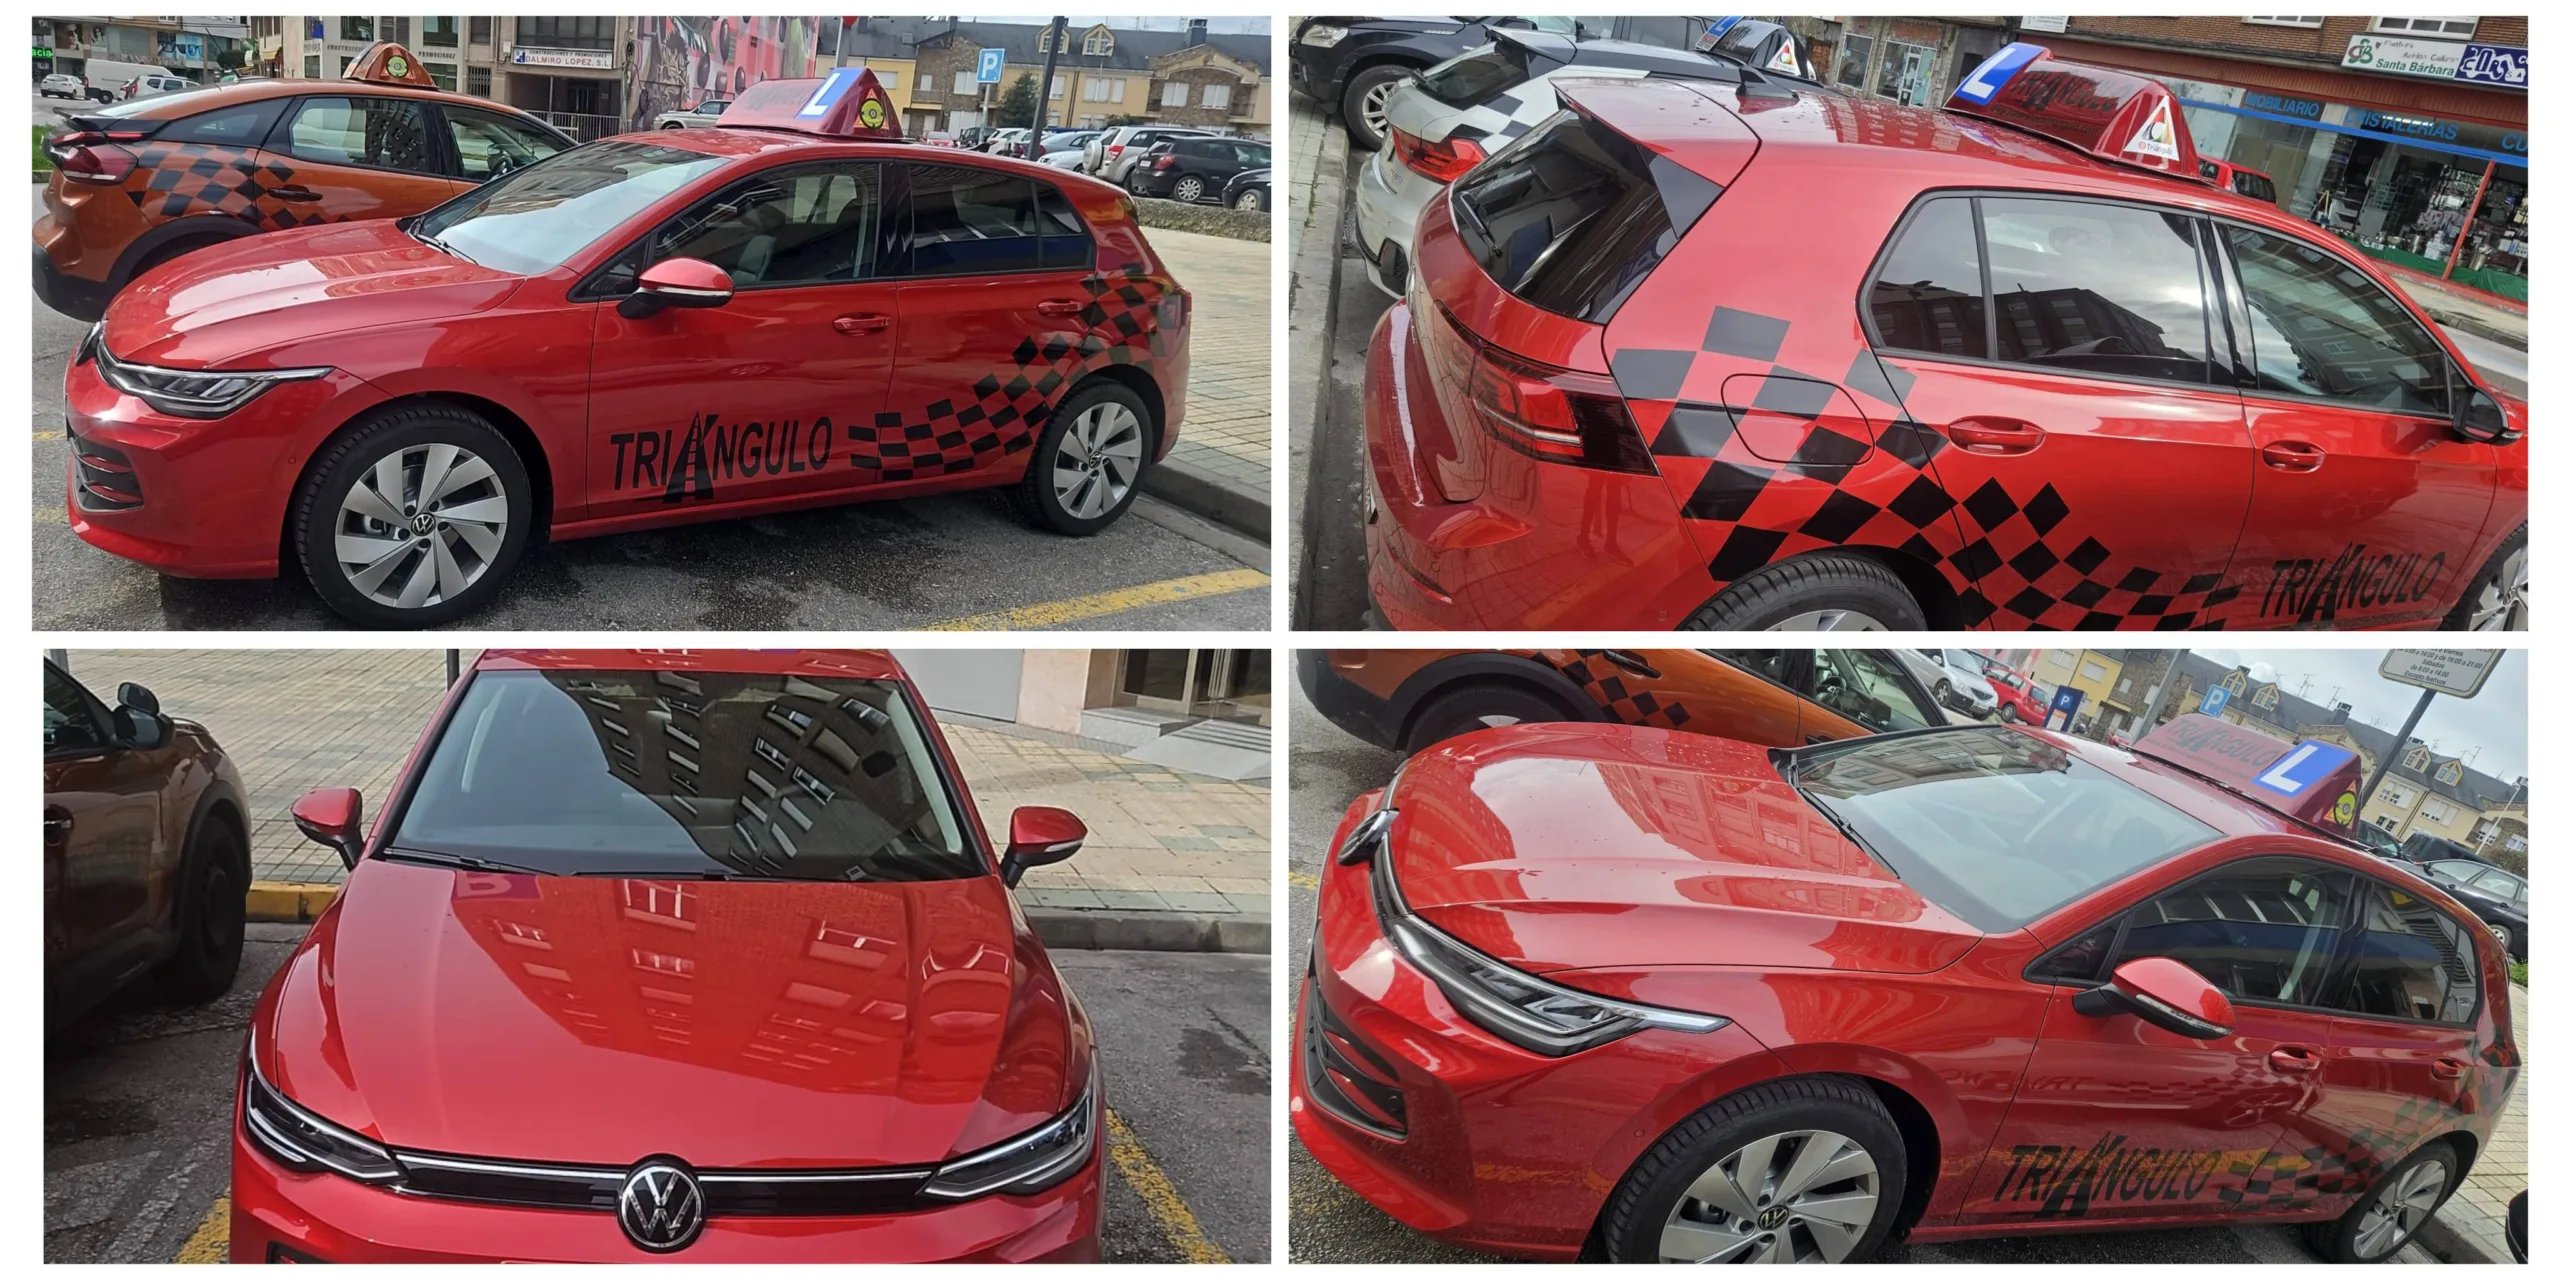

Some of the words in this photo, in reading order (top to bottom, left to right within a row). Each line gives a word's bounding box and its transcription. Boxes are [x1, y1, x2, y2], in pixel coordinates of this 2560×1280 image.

[526, 55, 561, 64] DALMIRO
[981, 53, 998, 79] P
[2375, 58, 2407, 71] Santa
[2408, 62, 2455, 76] Bárbara
[1961, 48, 2017, 99] L
[801, 72, 841, 116] L
[2245, 91, 2320, 118] MOBILIARIO
[2060, 695, 2070, 708] P
[2205, 690, 2224, 711] P
[2260, 744, 2319, 793] L
